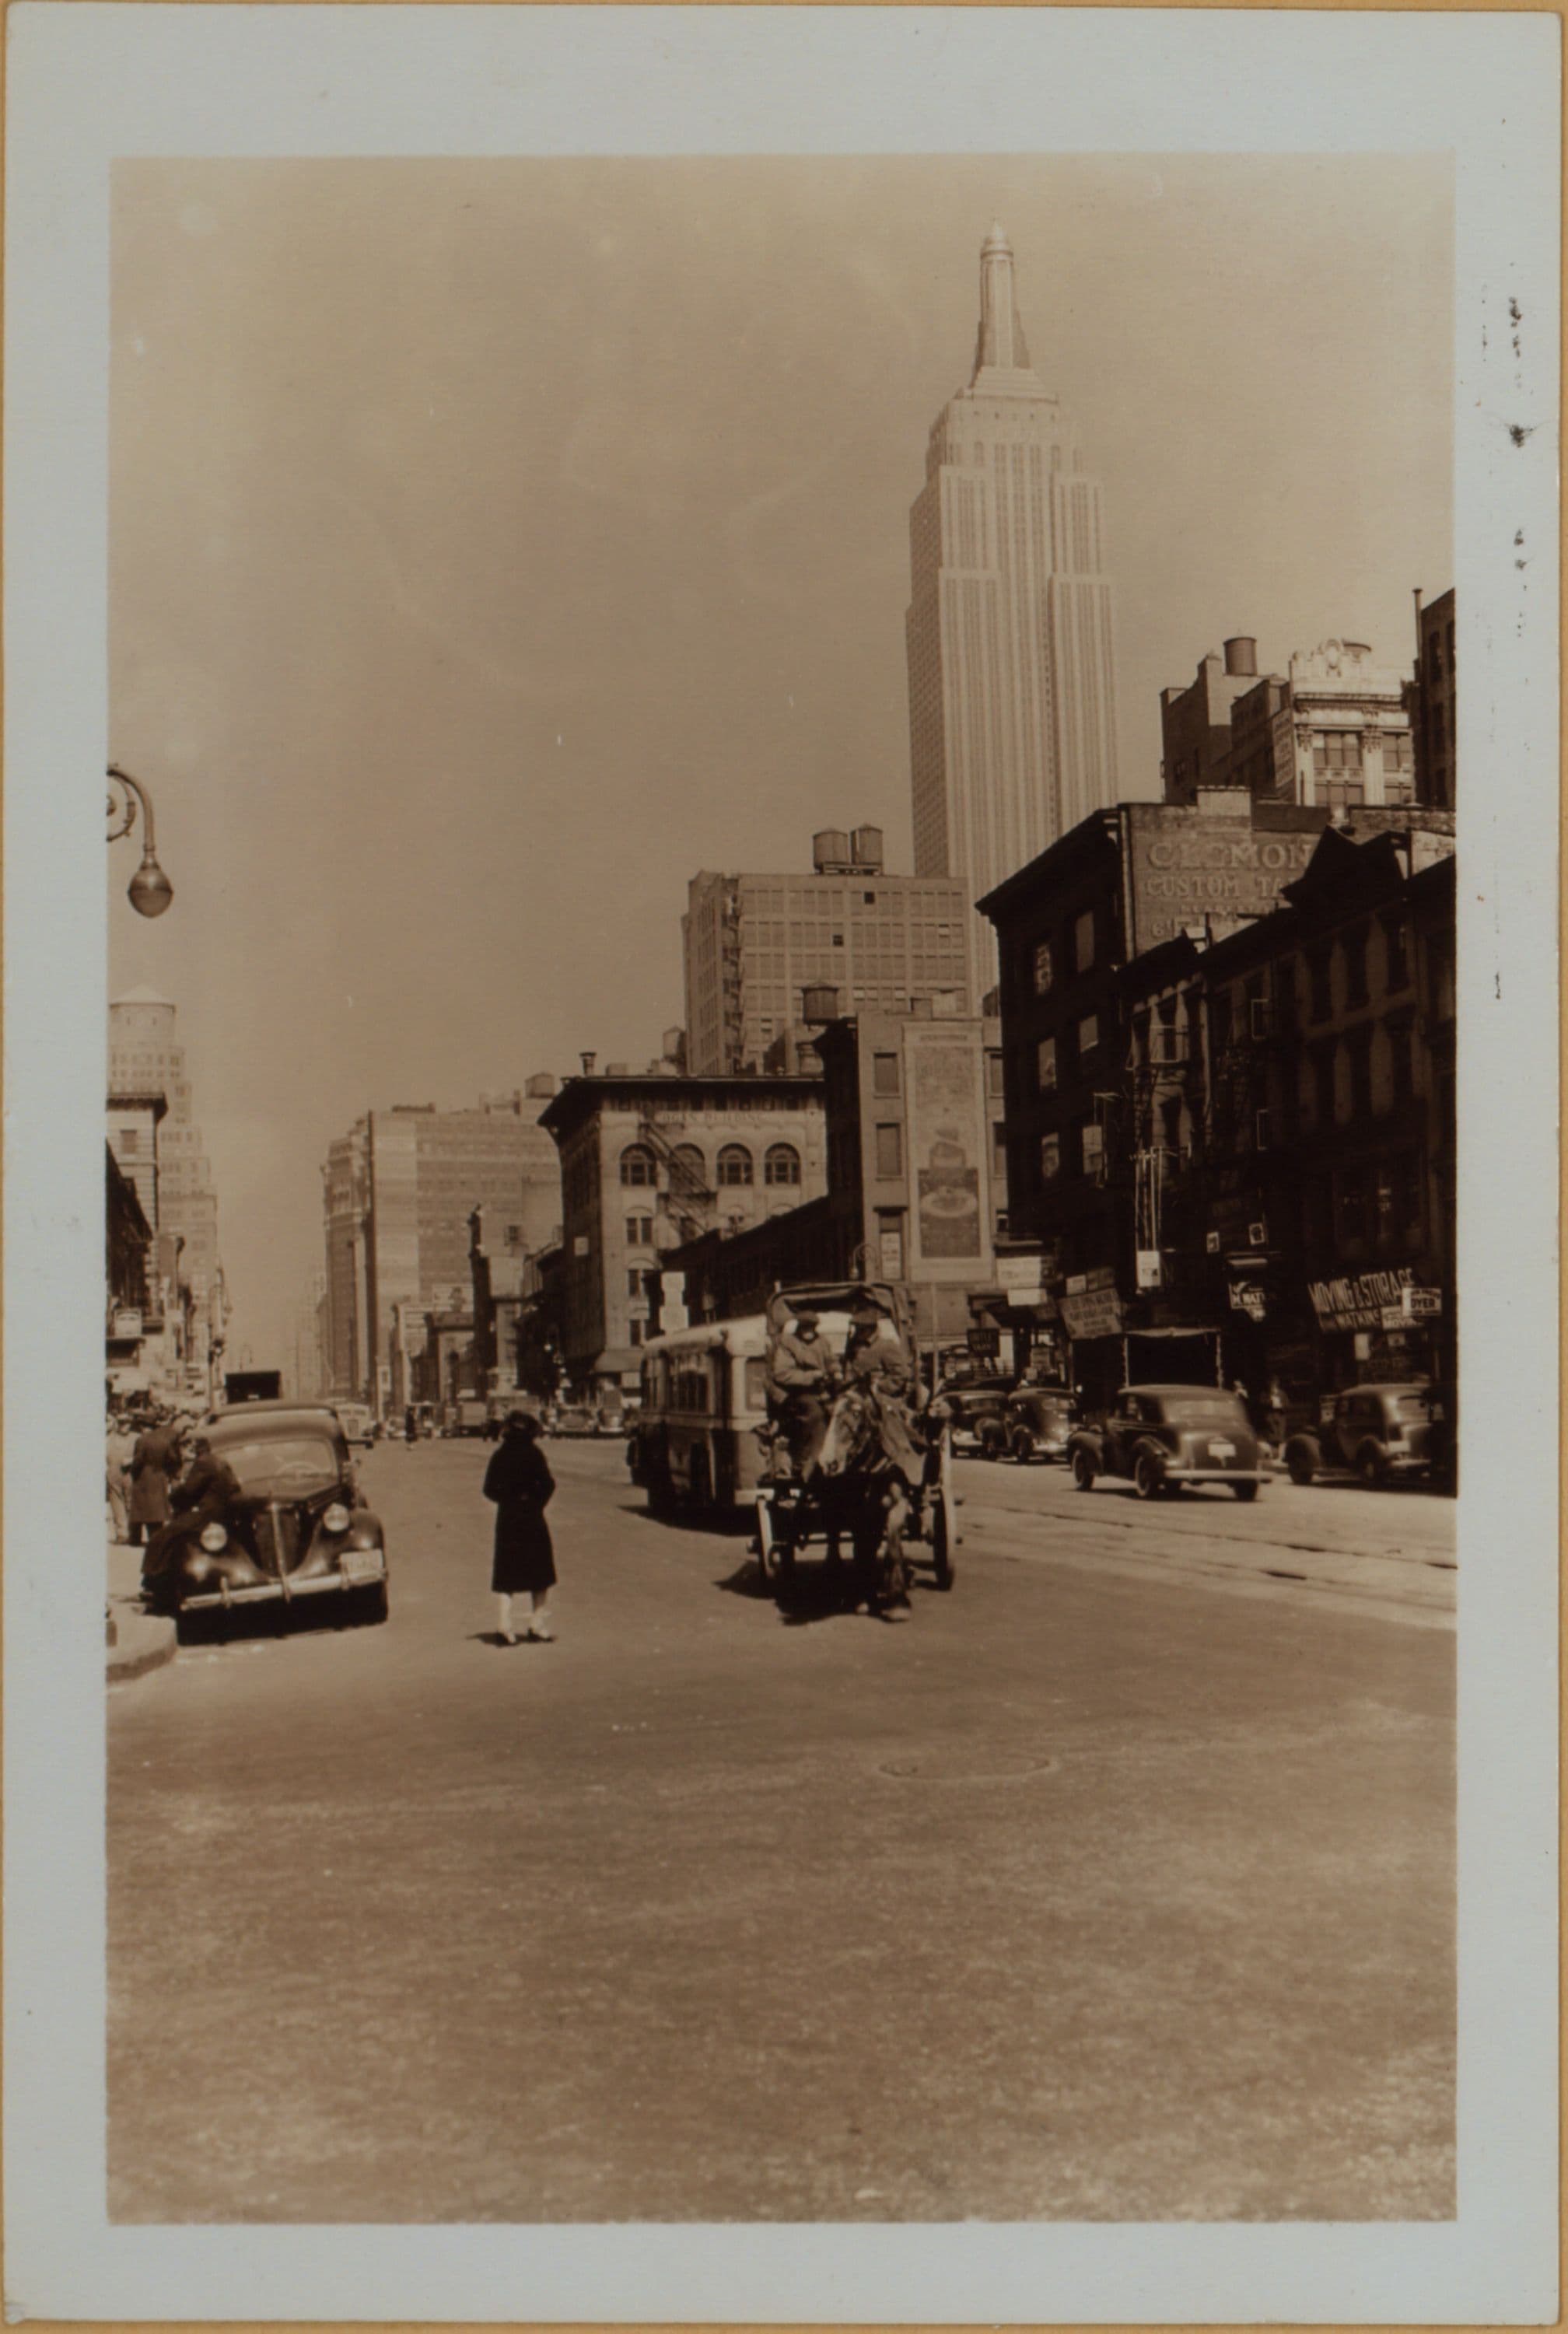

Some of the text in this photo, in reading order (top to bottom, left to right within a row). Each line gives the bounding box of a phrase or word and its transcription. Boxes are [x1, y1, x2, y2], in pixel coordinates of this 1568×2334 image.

[1146, 875, 1241, 898] CUSTOM
[1307, 1277, 1355, 1314] MOVING
[1360, 1267, 1416, 1307] STORAGE
[1411, 1297, 1436, 1309] DYER
